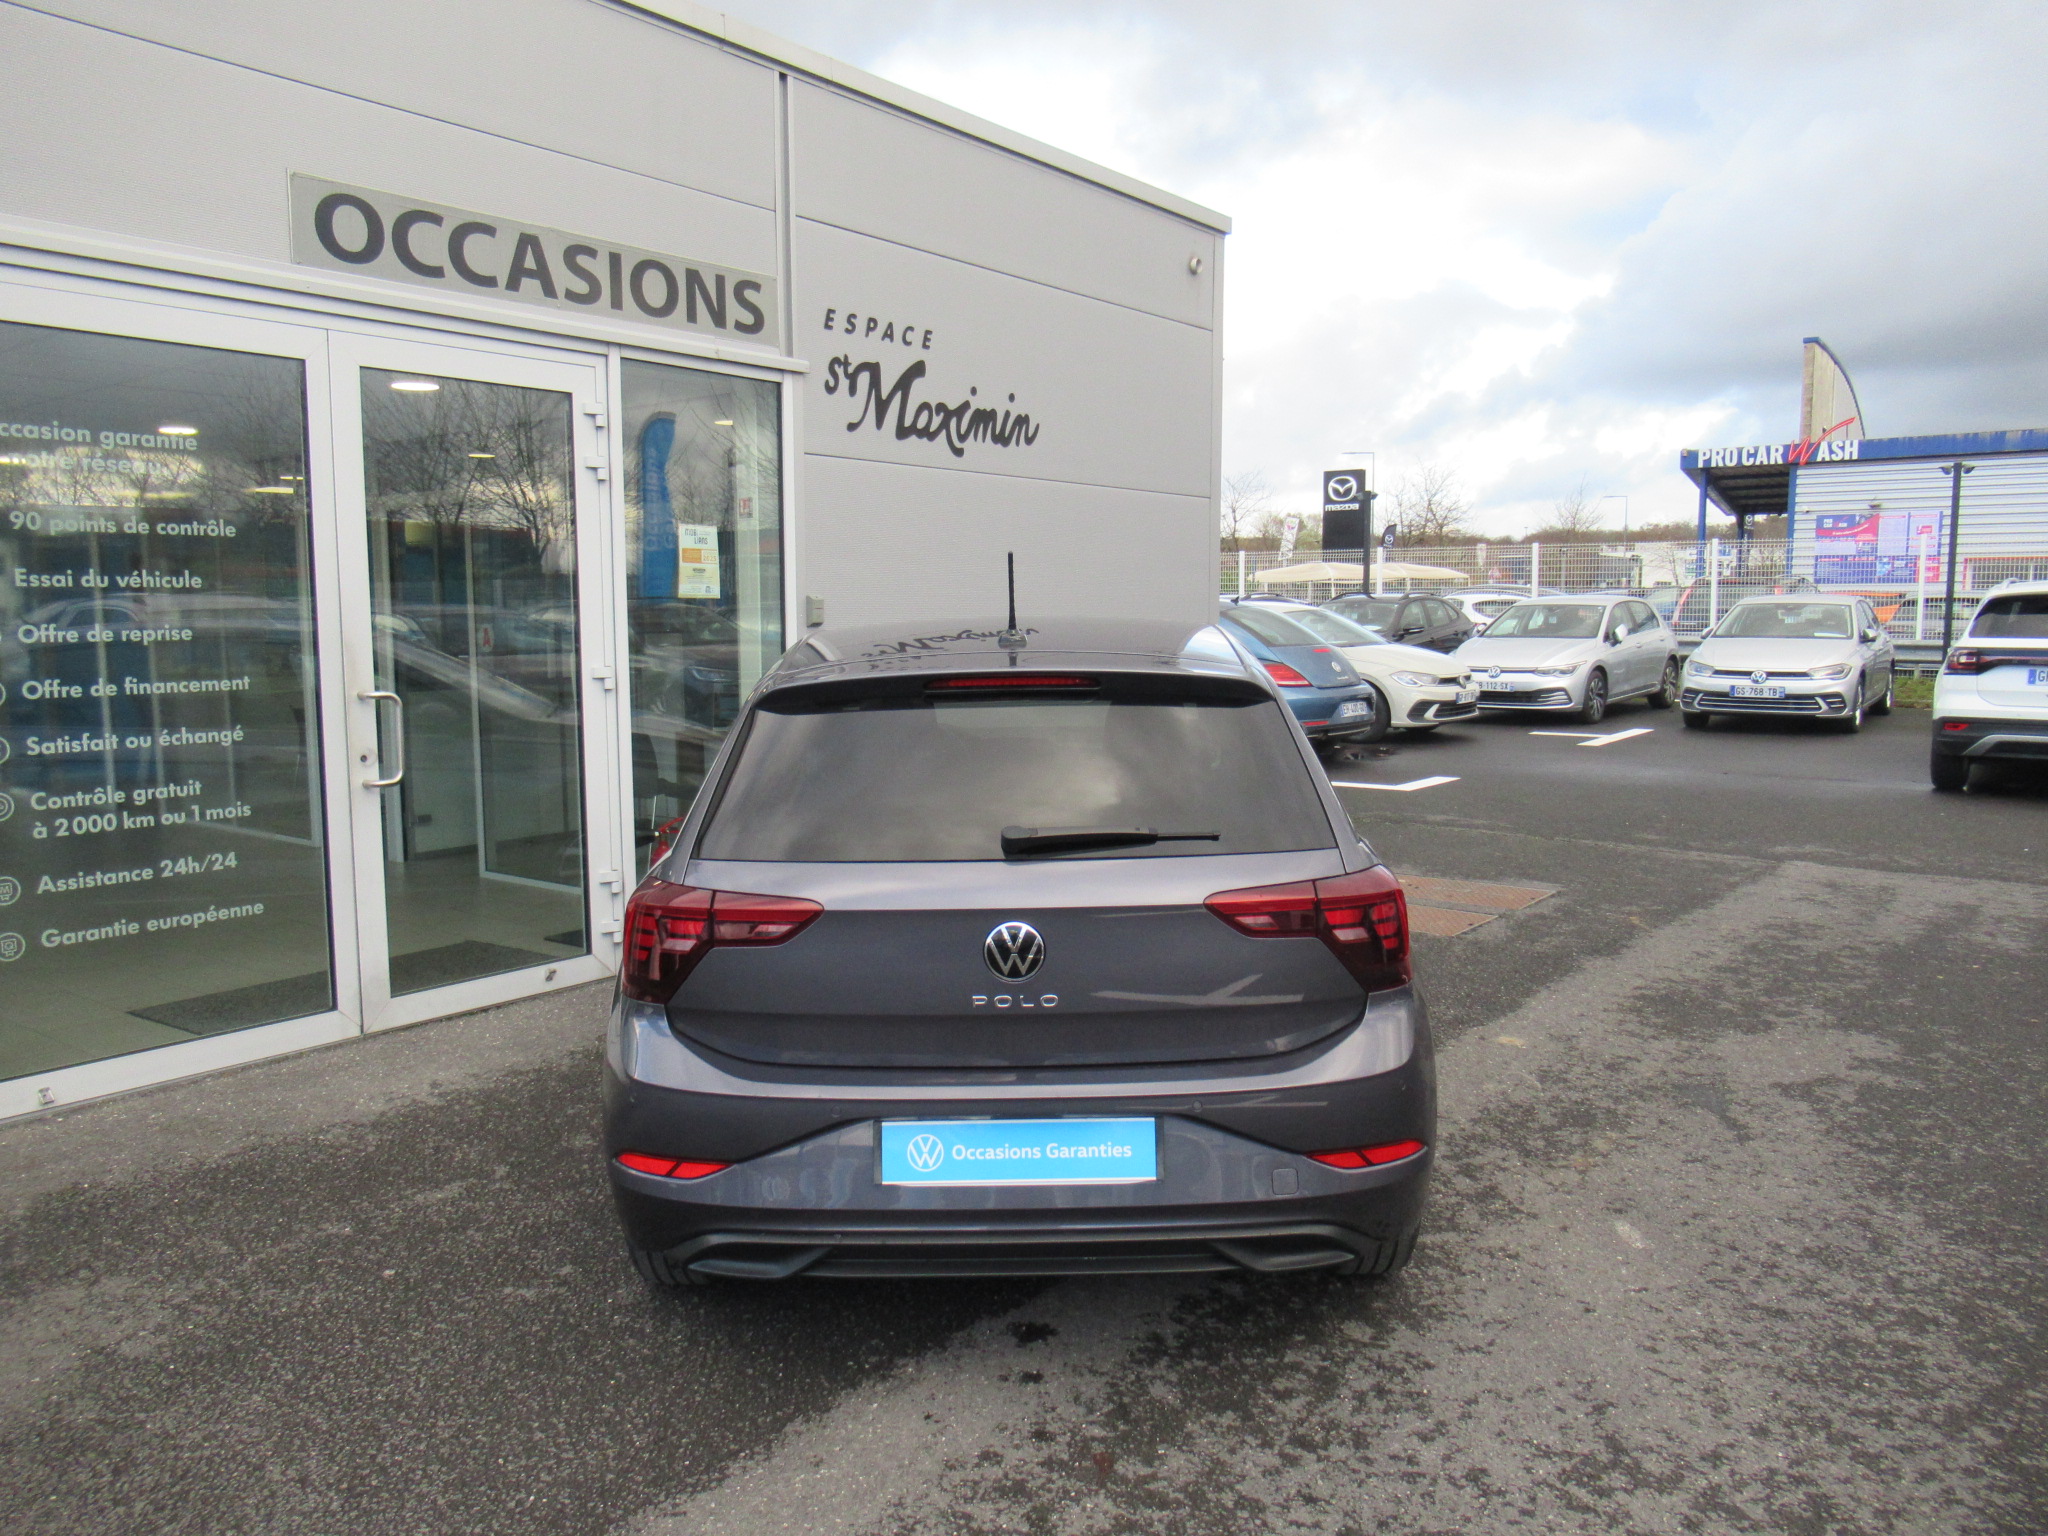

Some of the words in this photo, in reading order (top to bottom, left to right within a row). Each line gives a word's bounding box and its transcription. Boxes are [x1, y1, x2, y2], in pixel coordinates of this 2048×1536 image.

[314, 192, 765, 336] OCCASIONS
[824, 308, 934, 350] ESPACE
[846, 359, 1040, 458] Maximin
[100, 429, 199, 451] garantie
[1698, 448, 1738, 468] PRO
[1741, 444, 1785, 466] CAR
[9, 511, 42, 531] 90
[50, 516, 117, 536] points
[124, 516, 149, 534] de
[157, 518, 237, 538] contrôle
[14, 568, 73, 588] Essai
[81, 569, 109, 588] du
[116, 569, 203, 589] véhicule
[18, 624, 79, 644] Offre
[87, 624, 114, 642] de
[122, 625, 193, 645] reprise
[22, 679, 82, 700] Offre
[91, 678, 117, 697] de
[124, 676, 250, 696] financement
[1476, 681, 1509, 690] B-112-SX
[2037, 670, 2048, 682] G
[26, 733, 118, 756] Satisfait
[126, 735, 152, 748] ou
[159, 725, 244, 746] échangé
[31, 788, 125, 811] Contrôle
[133, 780, 203, 804] gratuit
[33, 824, 47, 839] à
[123, 814, 155, 829] km
[161, 812, 186, 826] ou
[191, 805, 200, 822] 1
[206, 802, 252, 821] mois
[37, 865, 154, 895] Assistance
[160, 851, 238, 879] 24h/24
[41, 918, 140, 949] Garantie
[147, 902, 264, 932] européenne
[972, 994, 1059, 1008] POLO
[952, 1143, 1041, 1161] Occasions
[1046, 1141, 1132, 1159] Garanties
